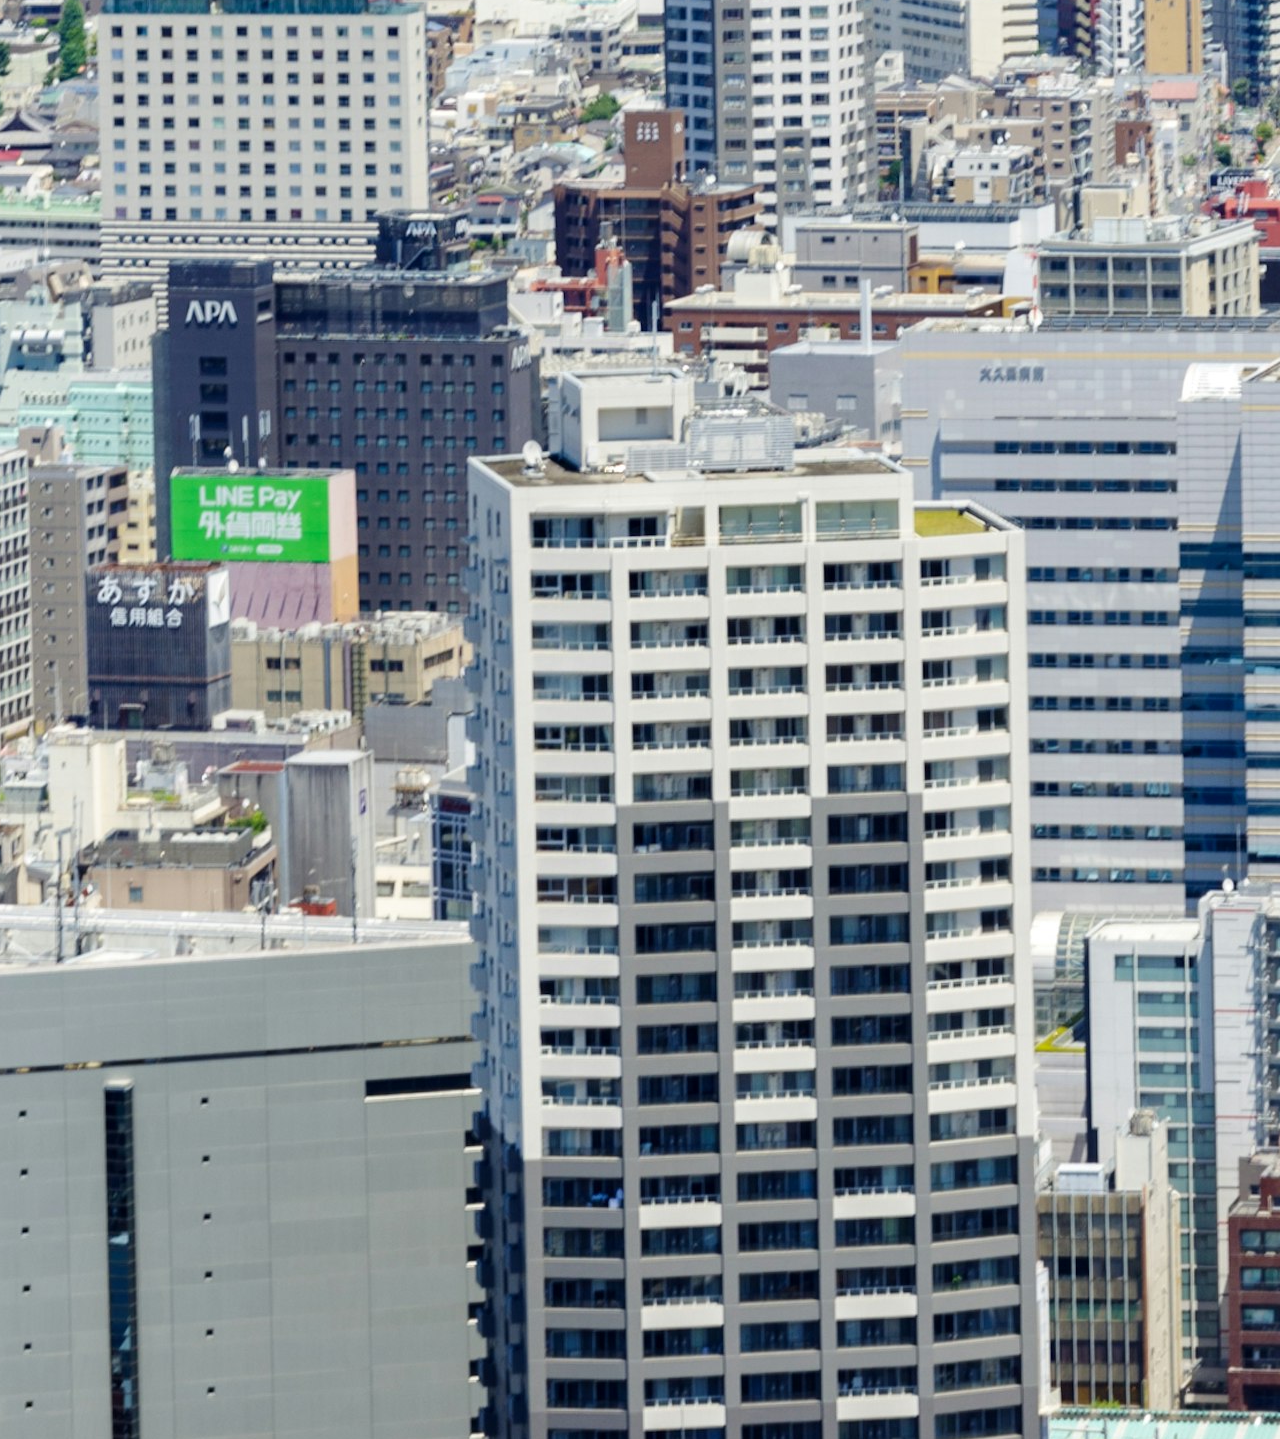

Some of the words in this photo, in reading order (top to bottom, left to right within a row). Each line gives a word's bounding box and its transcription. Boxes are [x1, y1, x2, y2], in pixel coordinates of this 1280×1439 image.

[407, 221, 438, 237] APA
[185, 300, 238, 325] APA
[199, 485, 254, 507] LINE
[258, 486, 302, 511] Pay
[198, 510, 302, 540] 外貨両替
[97, 575, 195, 607] あすか
[110, 607, 183, 628] 信用組合
